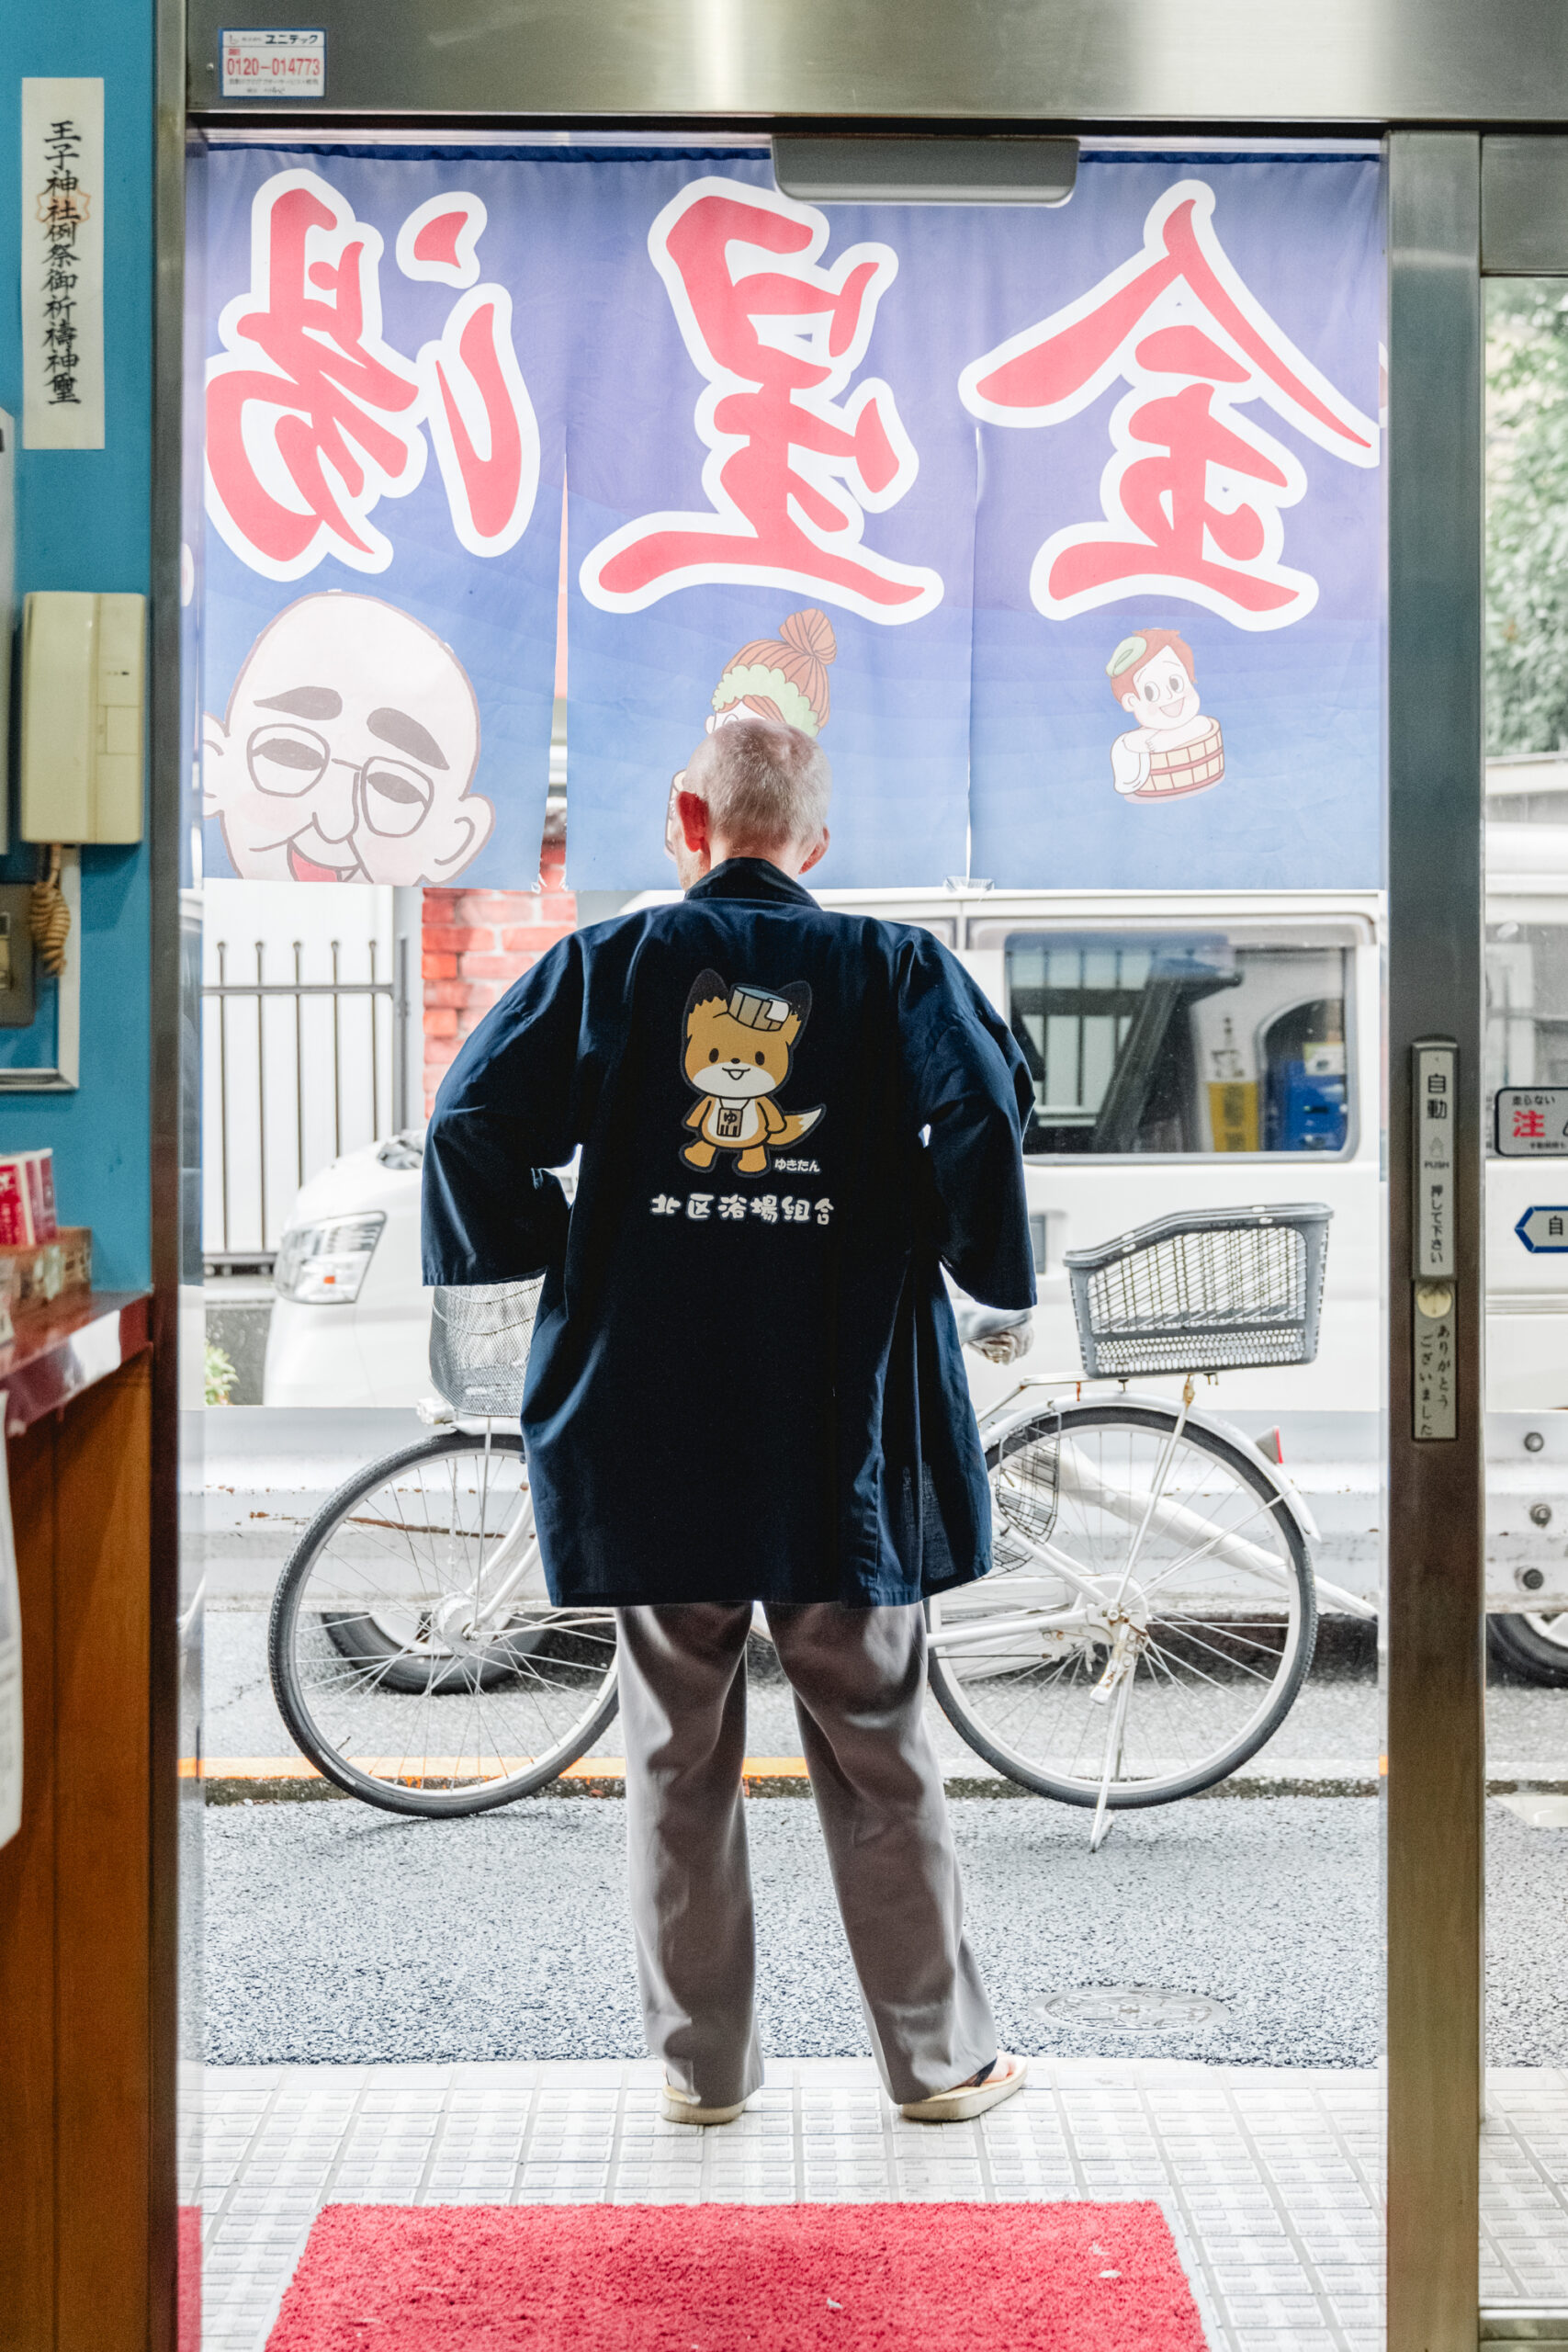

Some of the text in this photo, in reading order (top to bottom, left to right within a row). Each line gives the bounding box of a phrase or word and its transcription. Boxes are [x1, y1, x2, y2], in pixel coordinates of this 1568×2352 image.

[265, 34, 318, 44] ユニテック
[227, 57, 321, 75] 0120-014773
[1427, 1074, 1447, 1119] 自動
[723, 1110, 738, 1125] ゆ
[1513, 1110, 1545, 1138] 注
[774, 1159, 820, 1172] ゆきたん
[1424, 1160, 1450, 1169] PUSH
[651, 1193, 834, 1225] 北区浴場組合
[1549, 1216, 1563, 1236] 自
[1437, 1324, 1450, 1409] ありがとう
[1419, 1334, 1433, 1436] ございました
